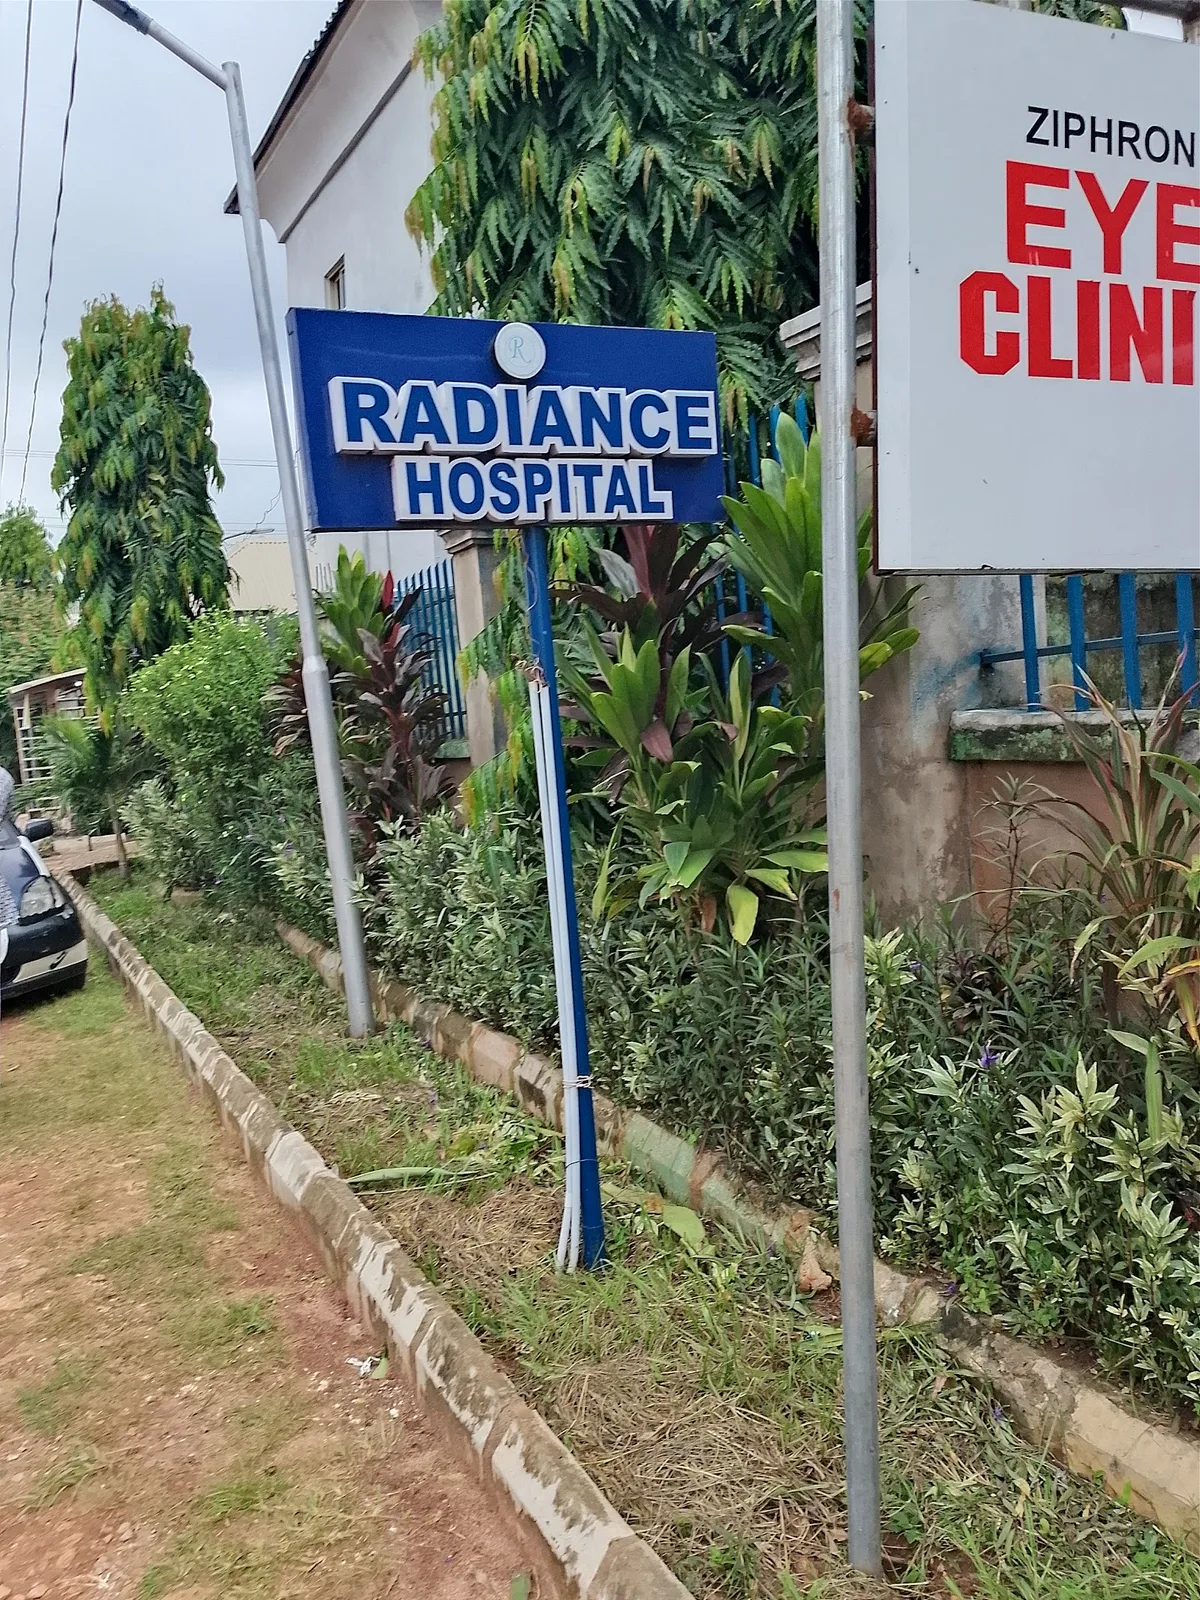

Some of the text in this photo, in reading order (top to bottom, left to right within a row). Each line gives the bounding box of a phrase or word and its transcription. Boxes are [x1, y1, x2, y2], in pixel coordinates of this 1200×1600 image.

[1026, 105, 1195, 167] ZIPHRON
[1006, 160, 1200, 283] EYE
[509, 335, 531, 364] R
[960, 270, 1196, 386] CLINI
[340, 380, 715, 452] RADIANCE
[404, 459, 667, 515] HOSPITAL
